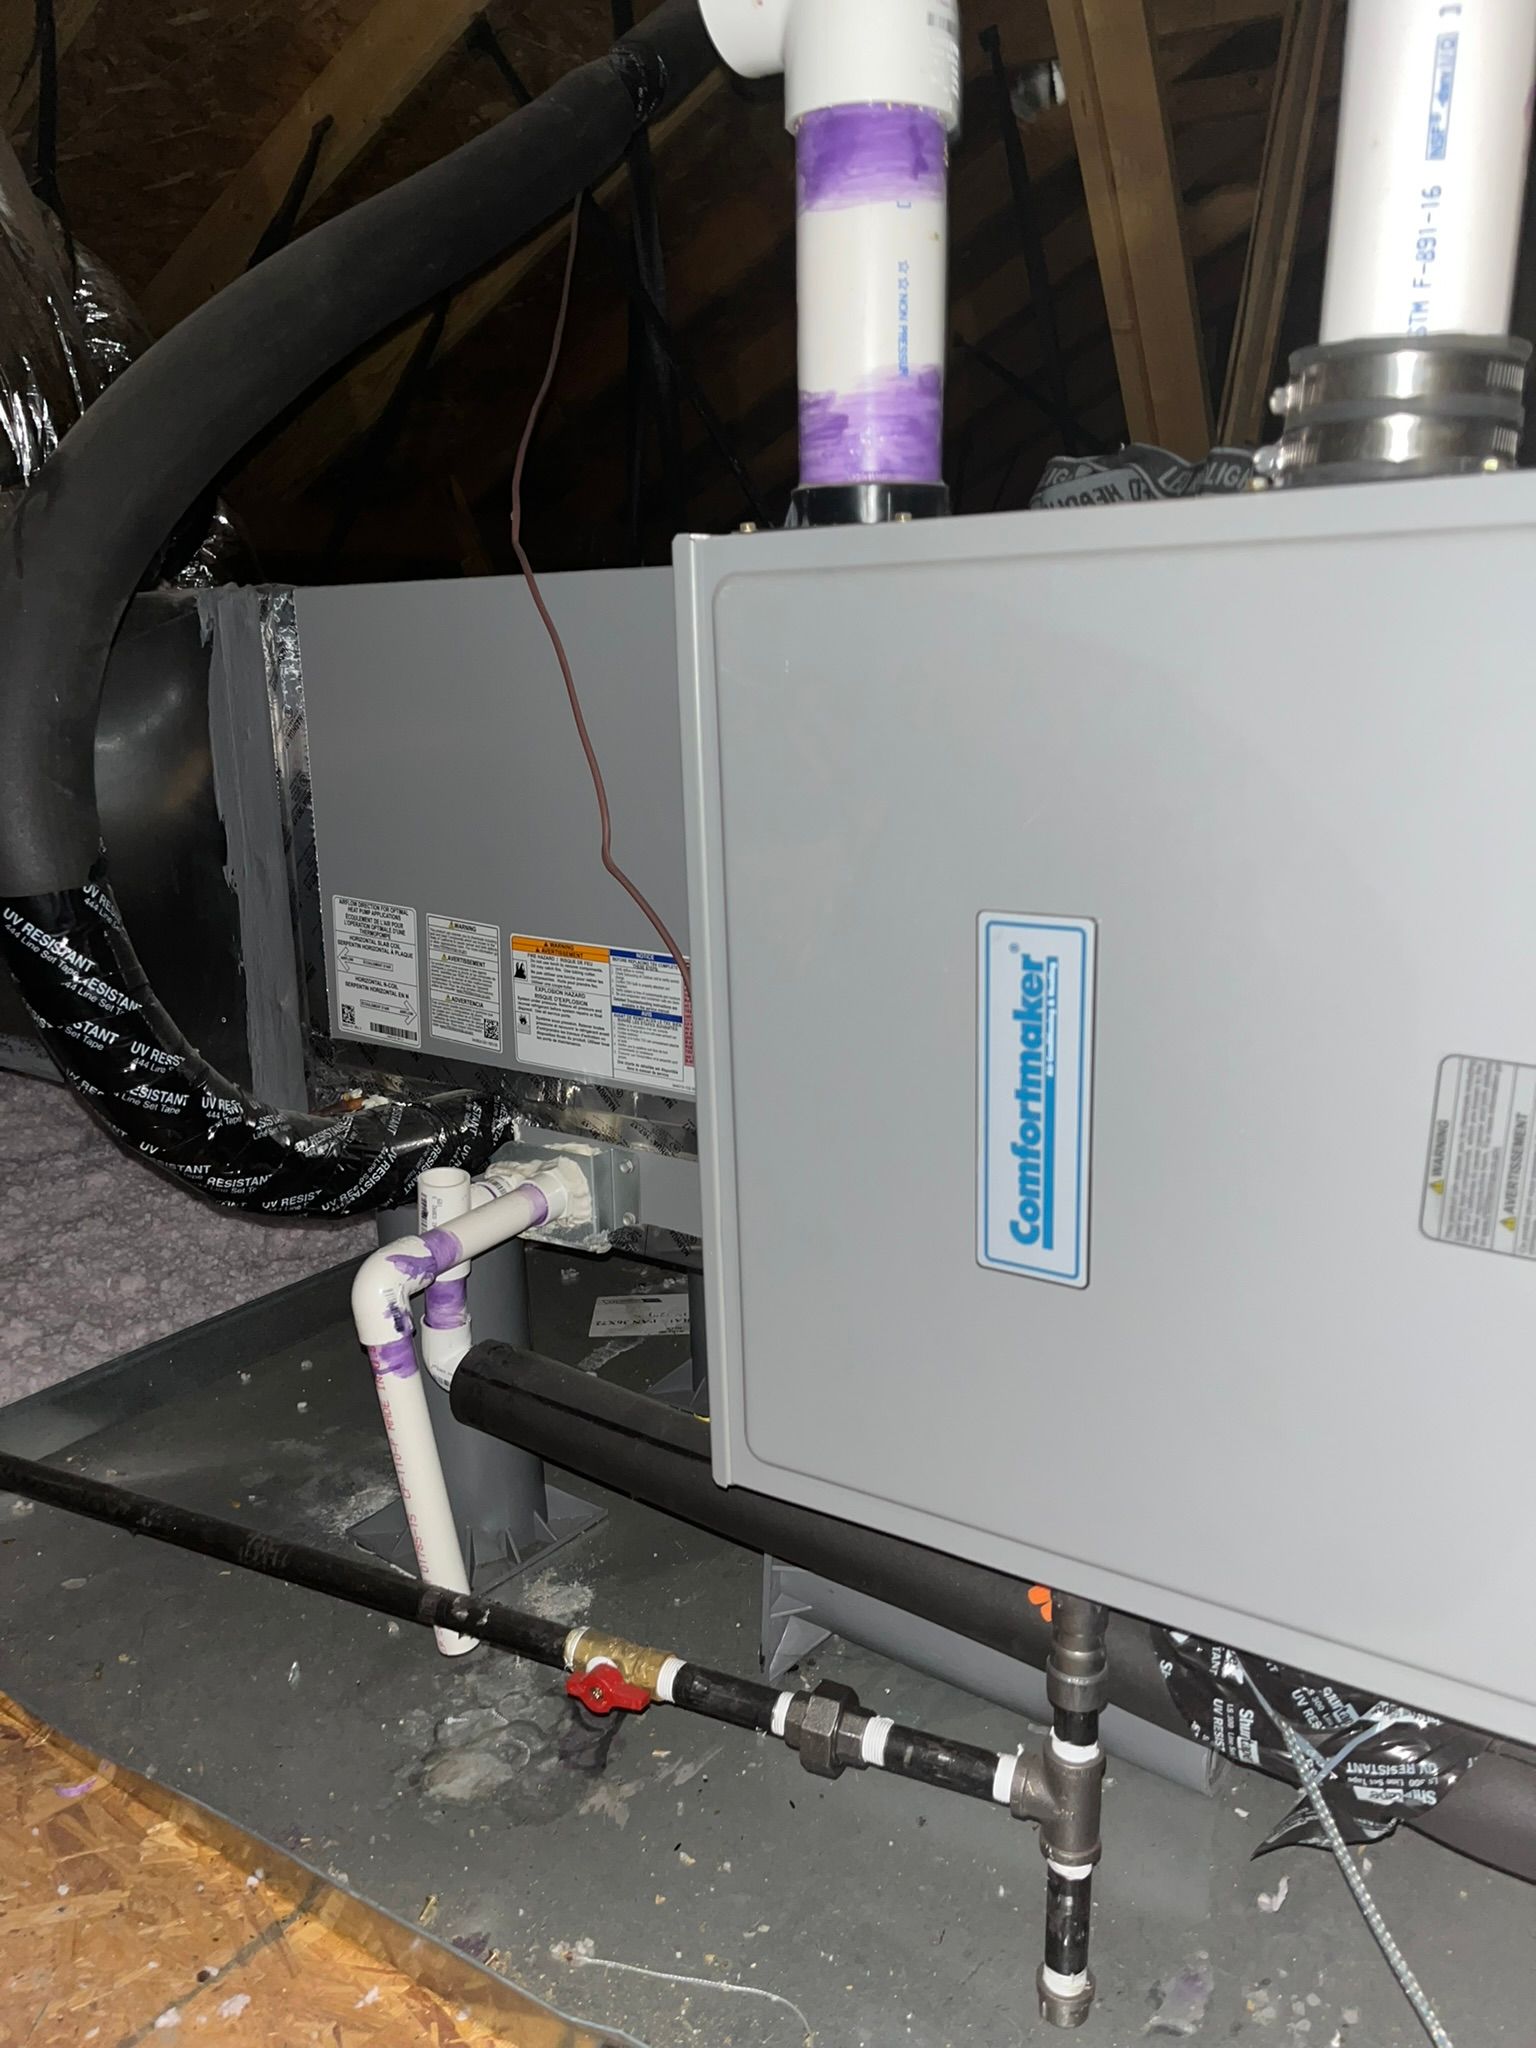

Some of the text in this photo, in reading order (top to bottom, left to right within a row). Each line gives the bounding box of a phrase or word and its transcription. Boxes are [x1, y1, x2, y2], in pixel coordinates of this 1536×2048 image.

[454, 923, 476, 932] WARNING
[2, 907, 96, 972] UV RESISTANT
[448, 956, 486, 968] AVERTISSEMENT
[452, 996, 484, 1009] ADVERTENCIA
[130, 1040, 150, 1056] UV
[202, 1096, 216, 1110] UV
[1009, 954, 1044, 1246] Comfortmaker
[140, 1141, 159, 1154] UV
[1432, 1119, 1450, 1176] WARNING
[1504, 1112, 1528, 1214] AVERTISSEMENT
[262, 1200, 279, 1210] UV
[321, 1199, 338, 1212] UV
[1291, 1688, 1309, 1707] UV
[1214, 1698, 1223, 1715] UV
[1346, 1762, 1416, 1775] RESISTANT
